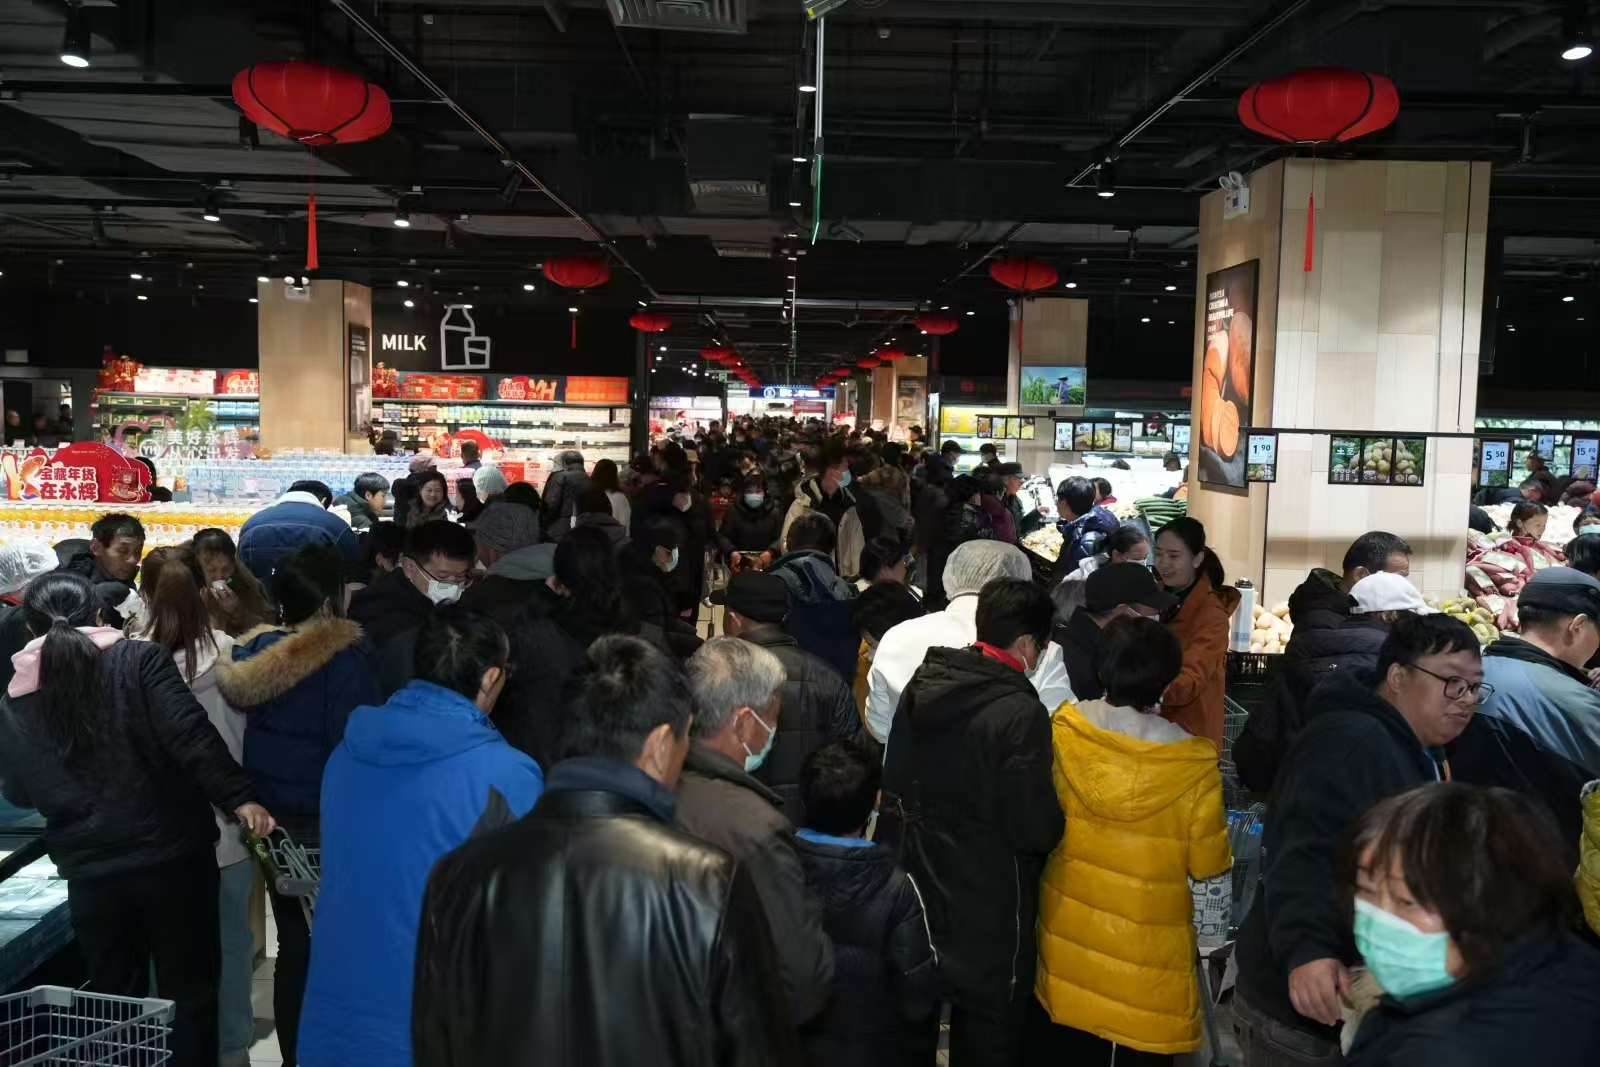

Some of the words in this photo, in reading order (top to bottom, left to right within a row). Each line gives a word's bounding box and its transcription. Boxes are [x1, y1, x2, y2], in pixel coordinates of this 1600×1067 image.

[382, 334, 427, 351] MILK
[167, 429, 240, 445] 美好永辉
[143, 445, 157, 456] YH
[1253, 444, 1271, 455] 1.90
[1336, 447, 1355, 456] 土豆
[1485, 450, 1505, 461] 5.50
[41, 467, 95, 481] 宝藏年货
[40, 482, 97, 501] 在永辉
